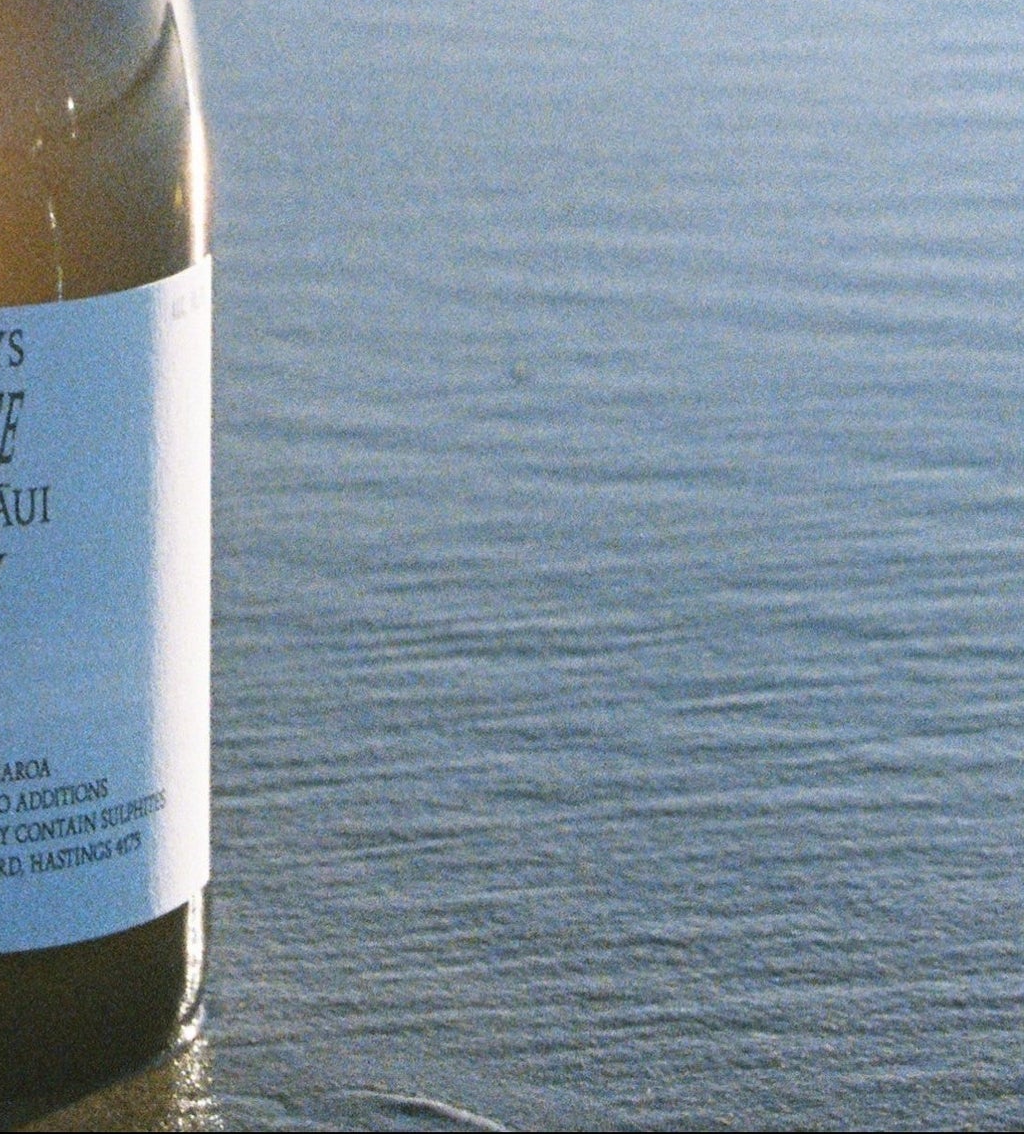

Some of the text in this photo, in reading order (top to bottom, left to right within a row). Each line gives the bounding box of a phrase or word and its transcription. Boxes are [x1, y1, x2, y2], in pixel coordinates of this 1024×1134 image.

[16, 778, 109, 812] ADDITIONS
[15, 815, 96, 844] CONTAIN
[30, 839, 111, 874] HASTINGS
